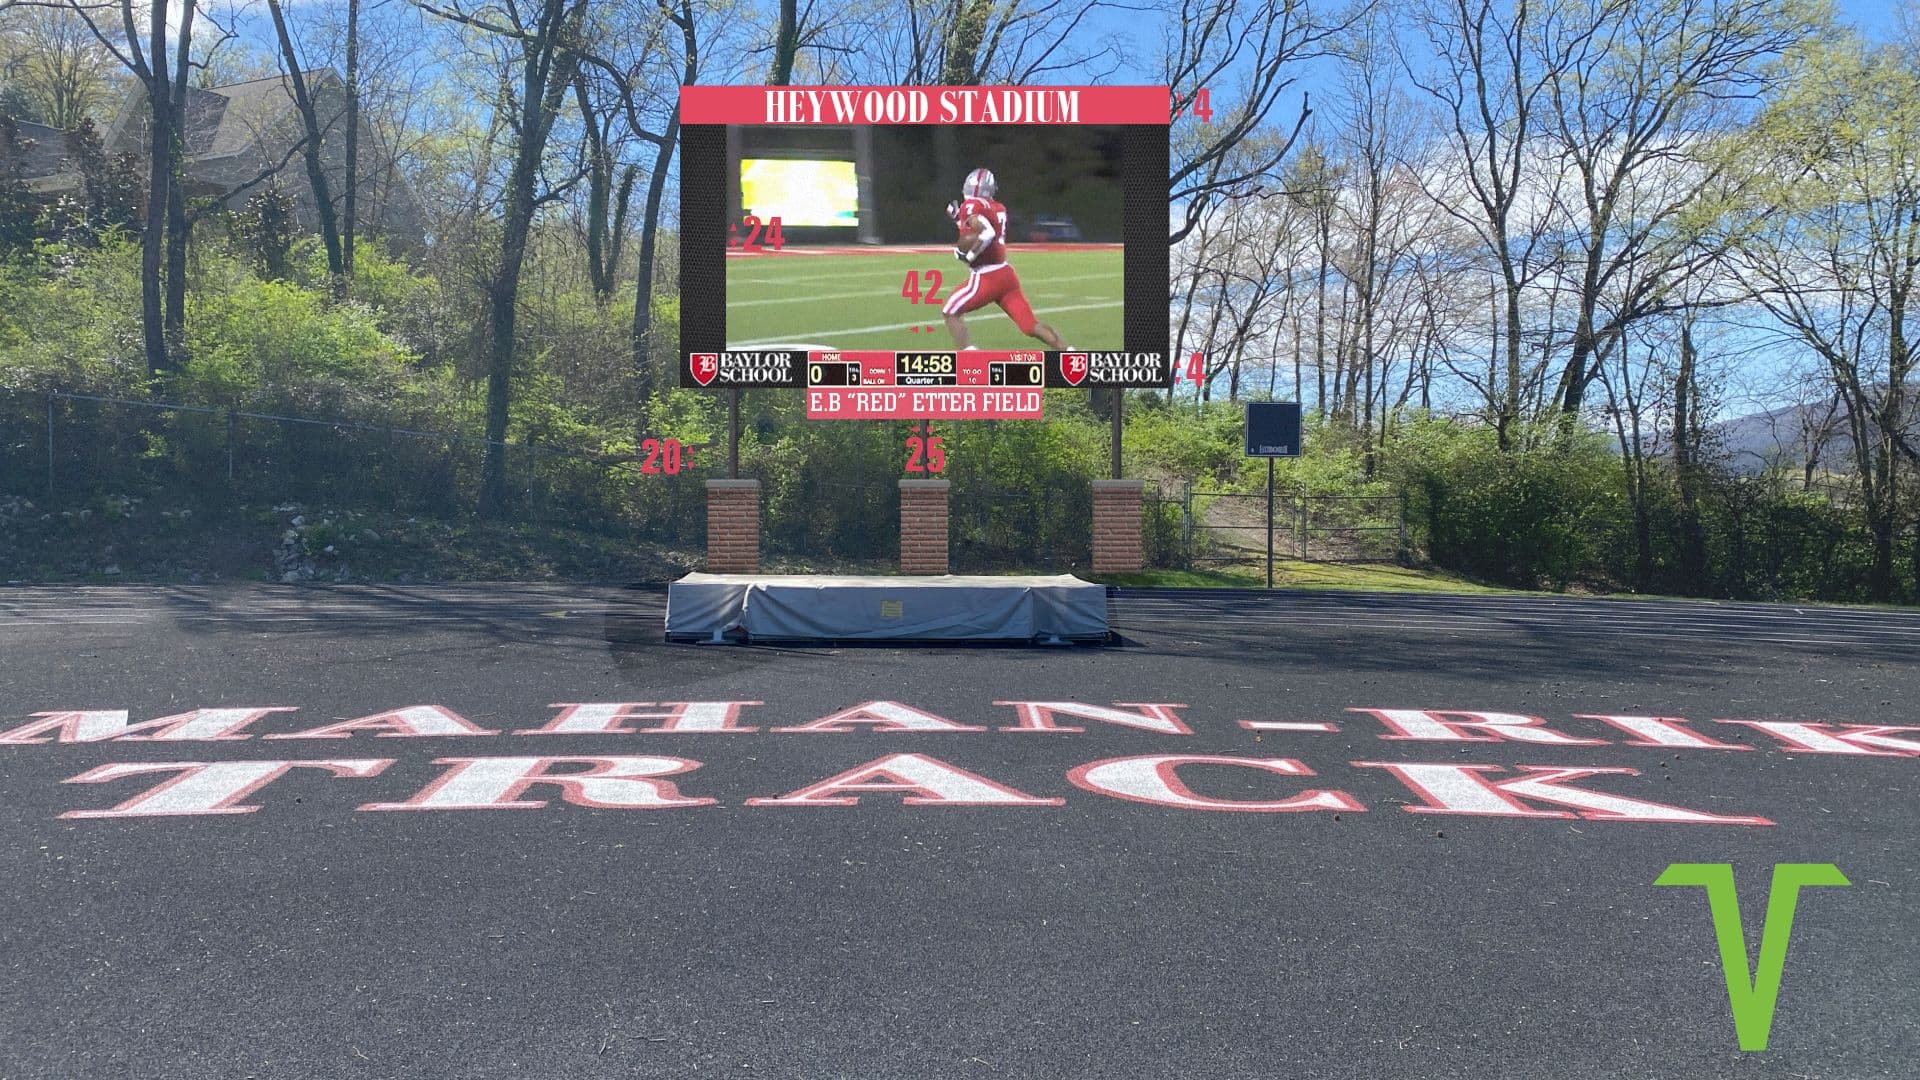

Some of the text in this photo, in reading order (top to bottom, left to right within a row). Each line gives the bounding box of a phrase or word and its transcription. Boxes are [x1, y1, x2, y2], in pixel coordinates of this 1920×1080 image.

[764, 90, 1080, 123] HEYWOOD STADIUM
[720, 352, 792, 368] BAYLOR
[900, 354, 953, 373] 14:58
[1090, 352, 1162, 368] BAYLOR
[720, 367, 793, 383] SCHOOL
[810, 365, 823, 384] 0
[905, 377, 935, 385] Quarter
[1029, 365, 1041, 384] 0
[1090, 367, 1162, 383] SCHOOL
[810, 392, 841, 412] E.B
[912, 392, 976, 412] ETTER
[982, 392, 1040, 412] FIELD
[57, 752, 1776, 827] TRACK
